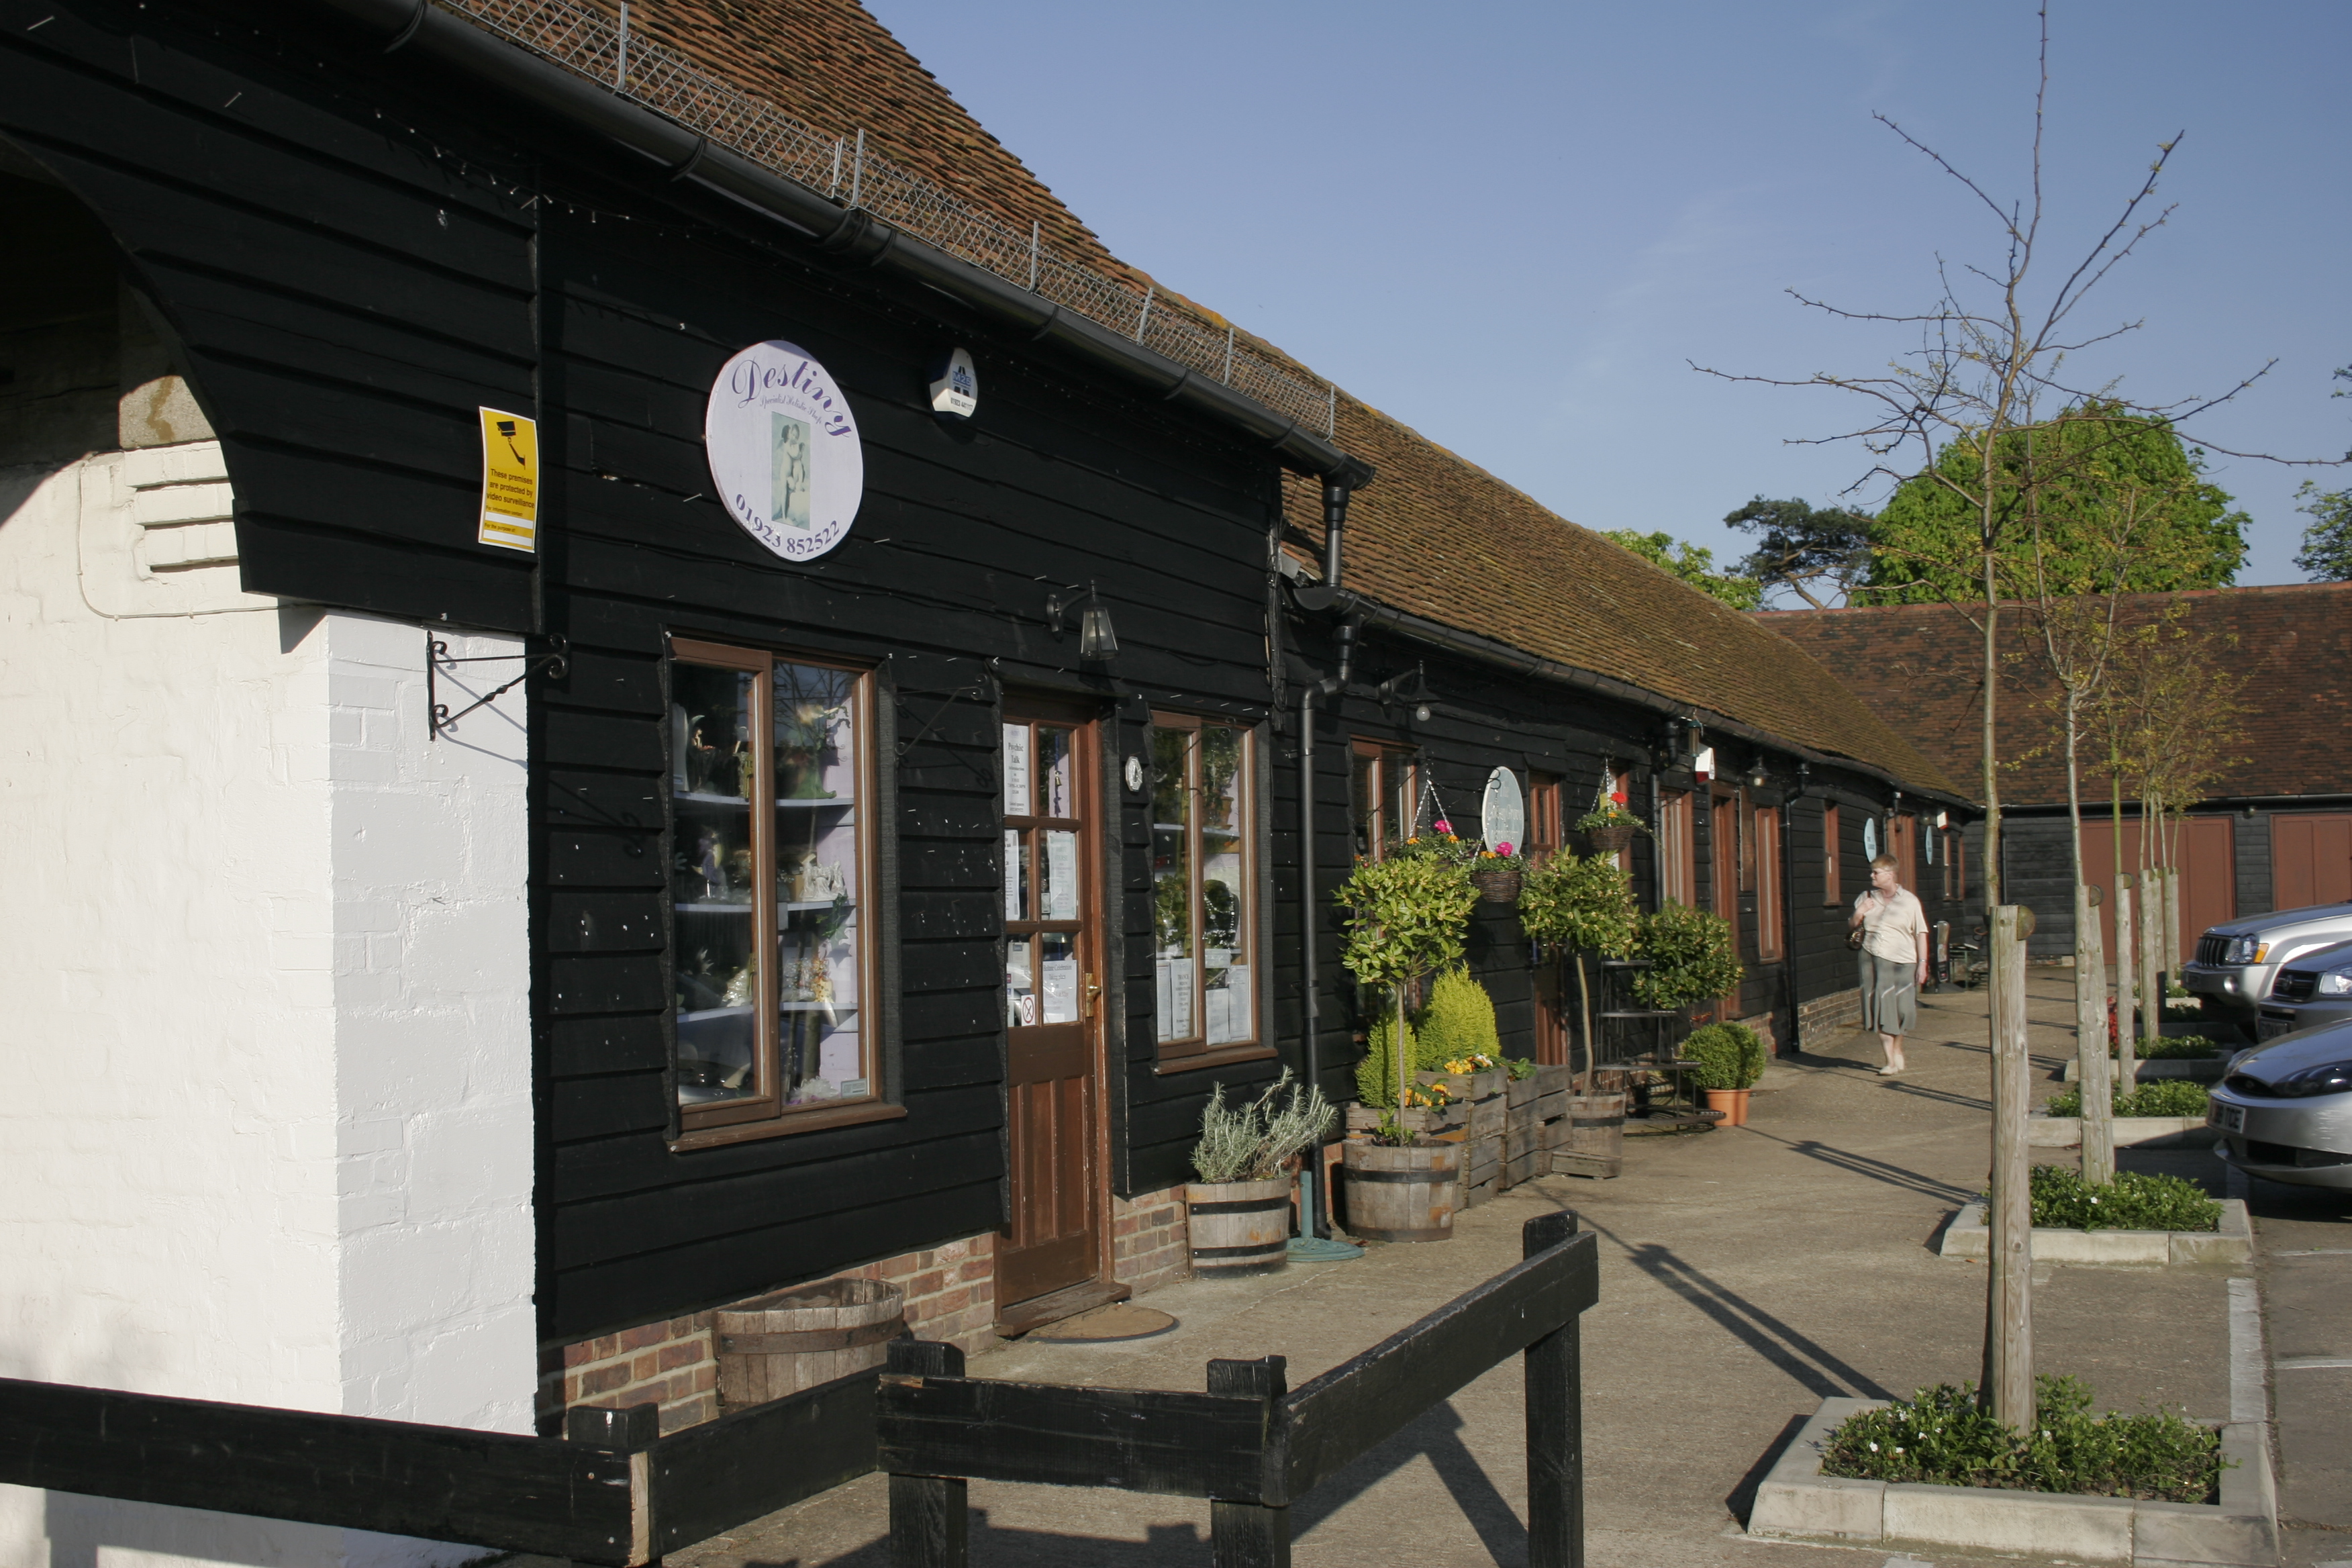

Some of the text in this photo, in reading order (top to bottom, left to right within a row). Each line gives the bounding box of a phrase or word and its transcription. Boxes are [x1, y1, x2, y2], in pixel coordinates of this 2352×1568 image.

[732, 356, 852, 438] Destiny
[807, 406, 822, 424] Shop
[491, 468, 533, 485] These premises
[499, 483, 526, 495] protected
[526, 488, 533, 498] by
[487, 492, 534, 508] video surveillance
[736, 493, 840, 555] 01923 852522
